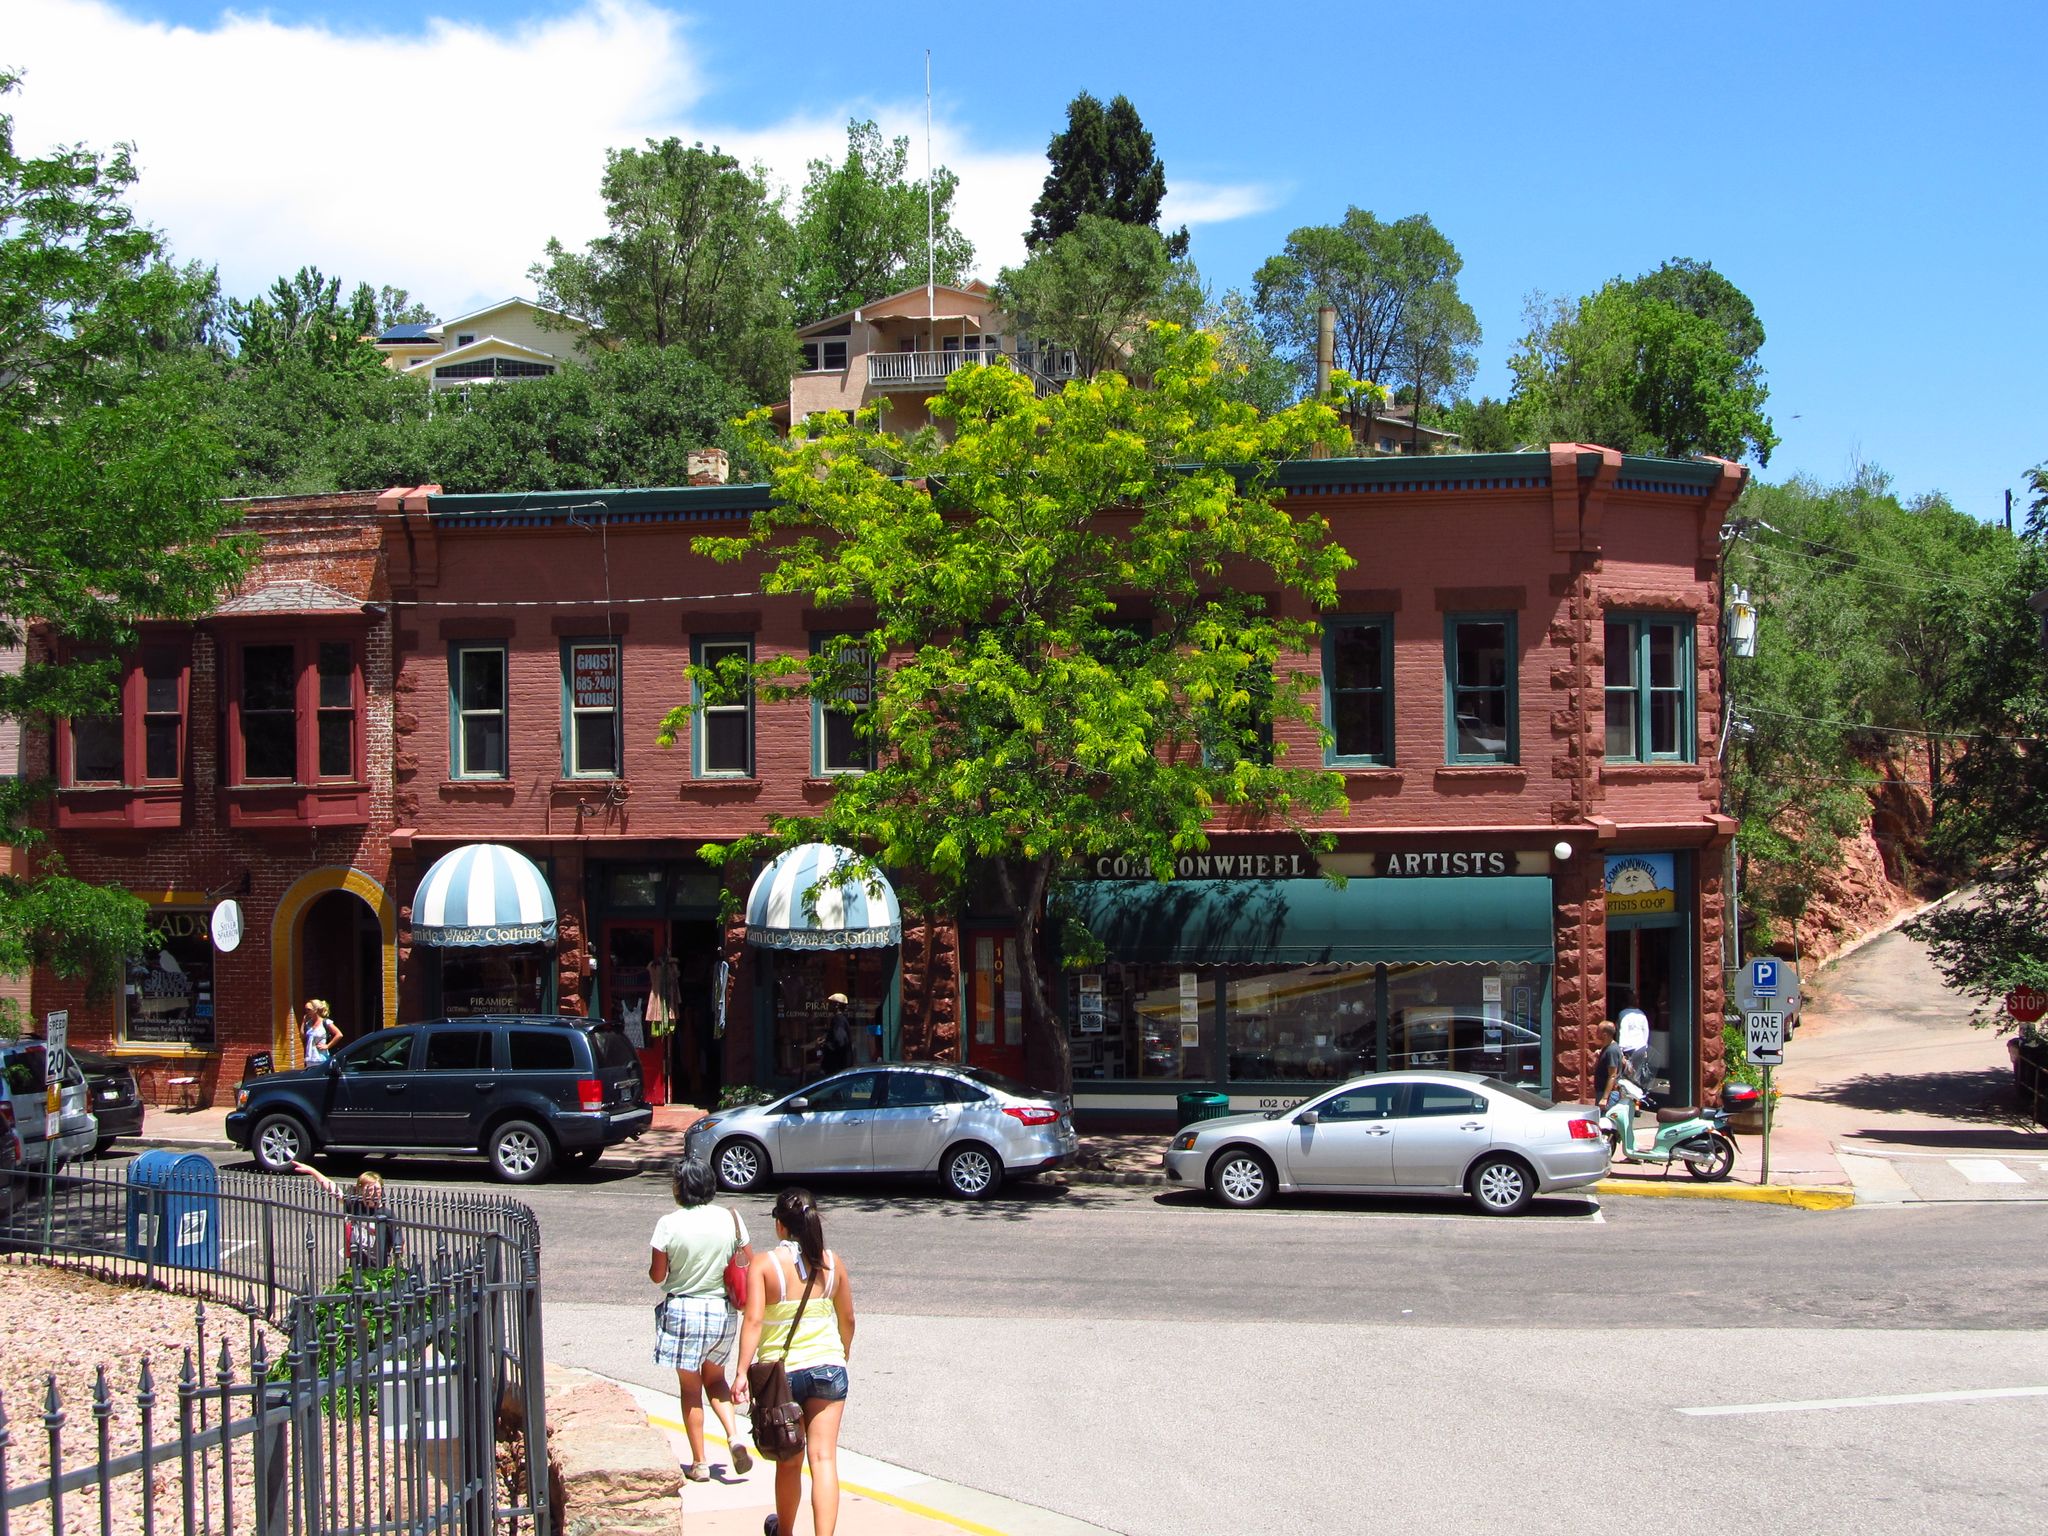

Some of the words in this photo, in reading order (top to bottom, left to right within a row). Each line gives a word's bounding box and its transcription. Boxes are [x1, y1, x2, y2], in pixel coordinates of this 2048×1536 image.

[576, 654, 615, 670] GHOST
[577, 692, 614, 706] TOURS
[1096, 854, 1306, 878] COMONWHEEL
[1386, 852, 1506, 875] ARTISTS
[1605, 857, 1658, 885] COMMONWHEEL
[485, 926, 542, 942] Clothing
[833, 929, 890, 945] Clothing
[1757, 964, 1773, 984] P
[470, 997, 514, 1007] PIRAMIDE
[2009, 995, 2046, 1010] STOP
[48, 1019, 66, 1031] SPEED
[1751, 1015, 1779, 1029] ONE
[1750, 1030, 1780, 1043] WAY
[48, 1048, 64, 1076] 20
[1259, 1099, 1278, 1108] 102
